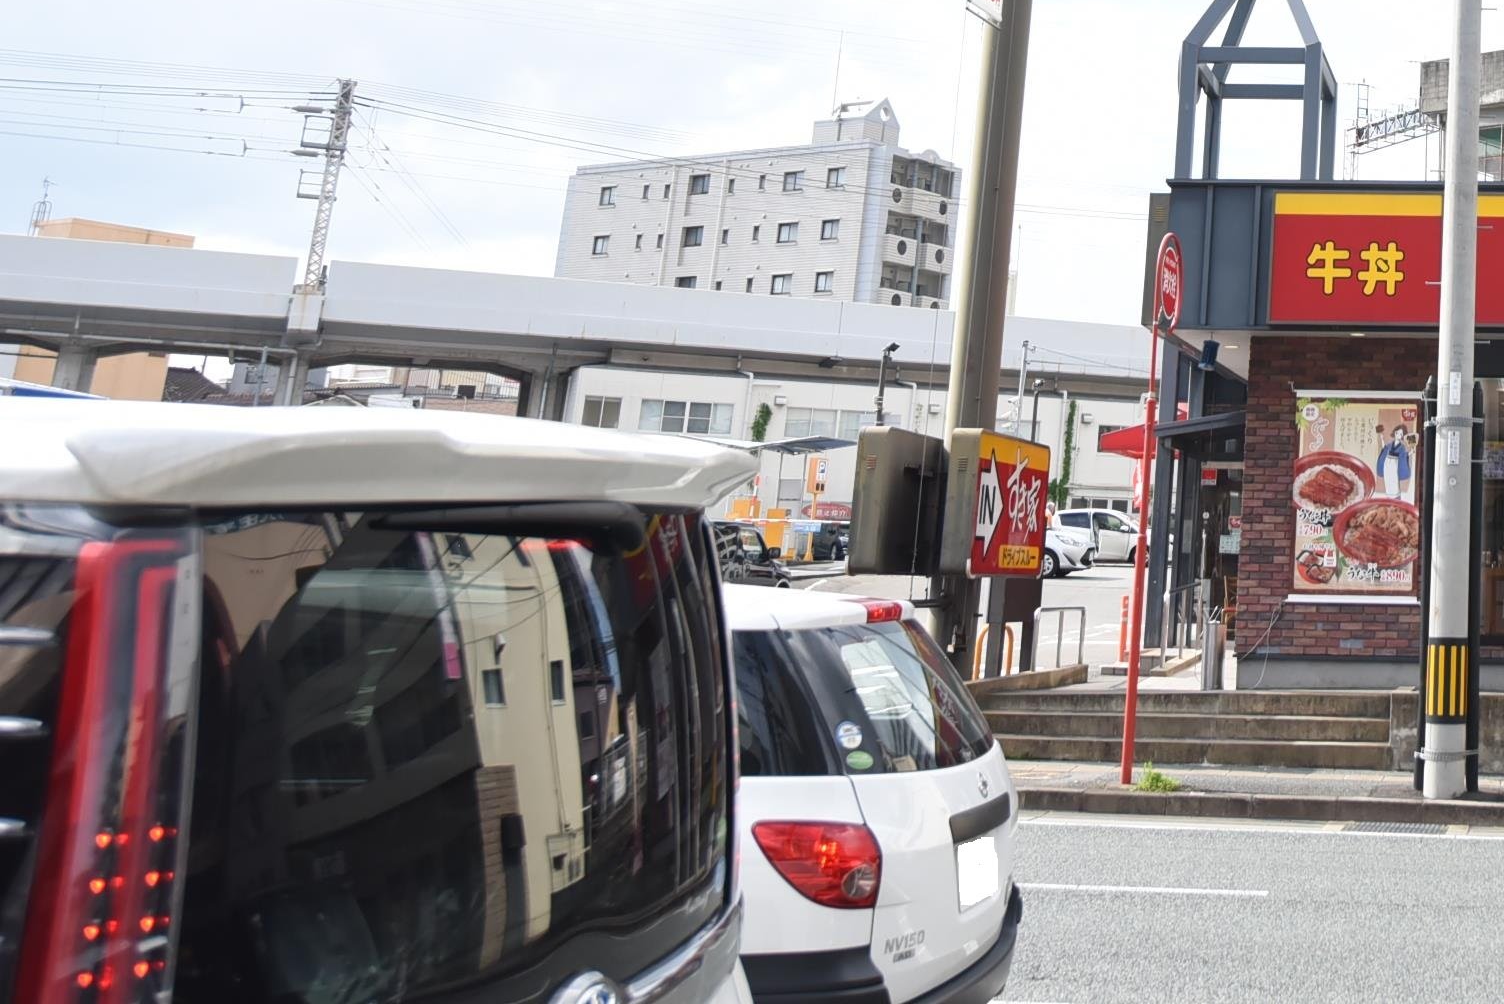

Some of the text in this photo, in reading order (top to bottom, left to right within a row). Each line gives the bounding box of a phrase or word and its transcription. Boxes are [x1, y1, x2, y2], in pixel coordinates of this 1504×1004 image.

[1306, 240, 1405, 296] 牛丼
[979, 483, 996, 525] IN
[1007, 447, 1041, 543] すき家
[1001, 547, 1036, 566] ドライブスルー
[884, 930, 926, 954] NV150
